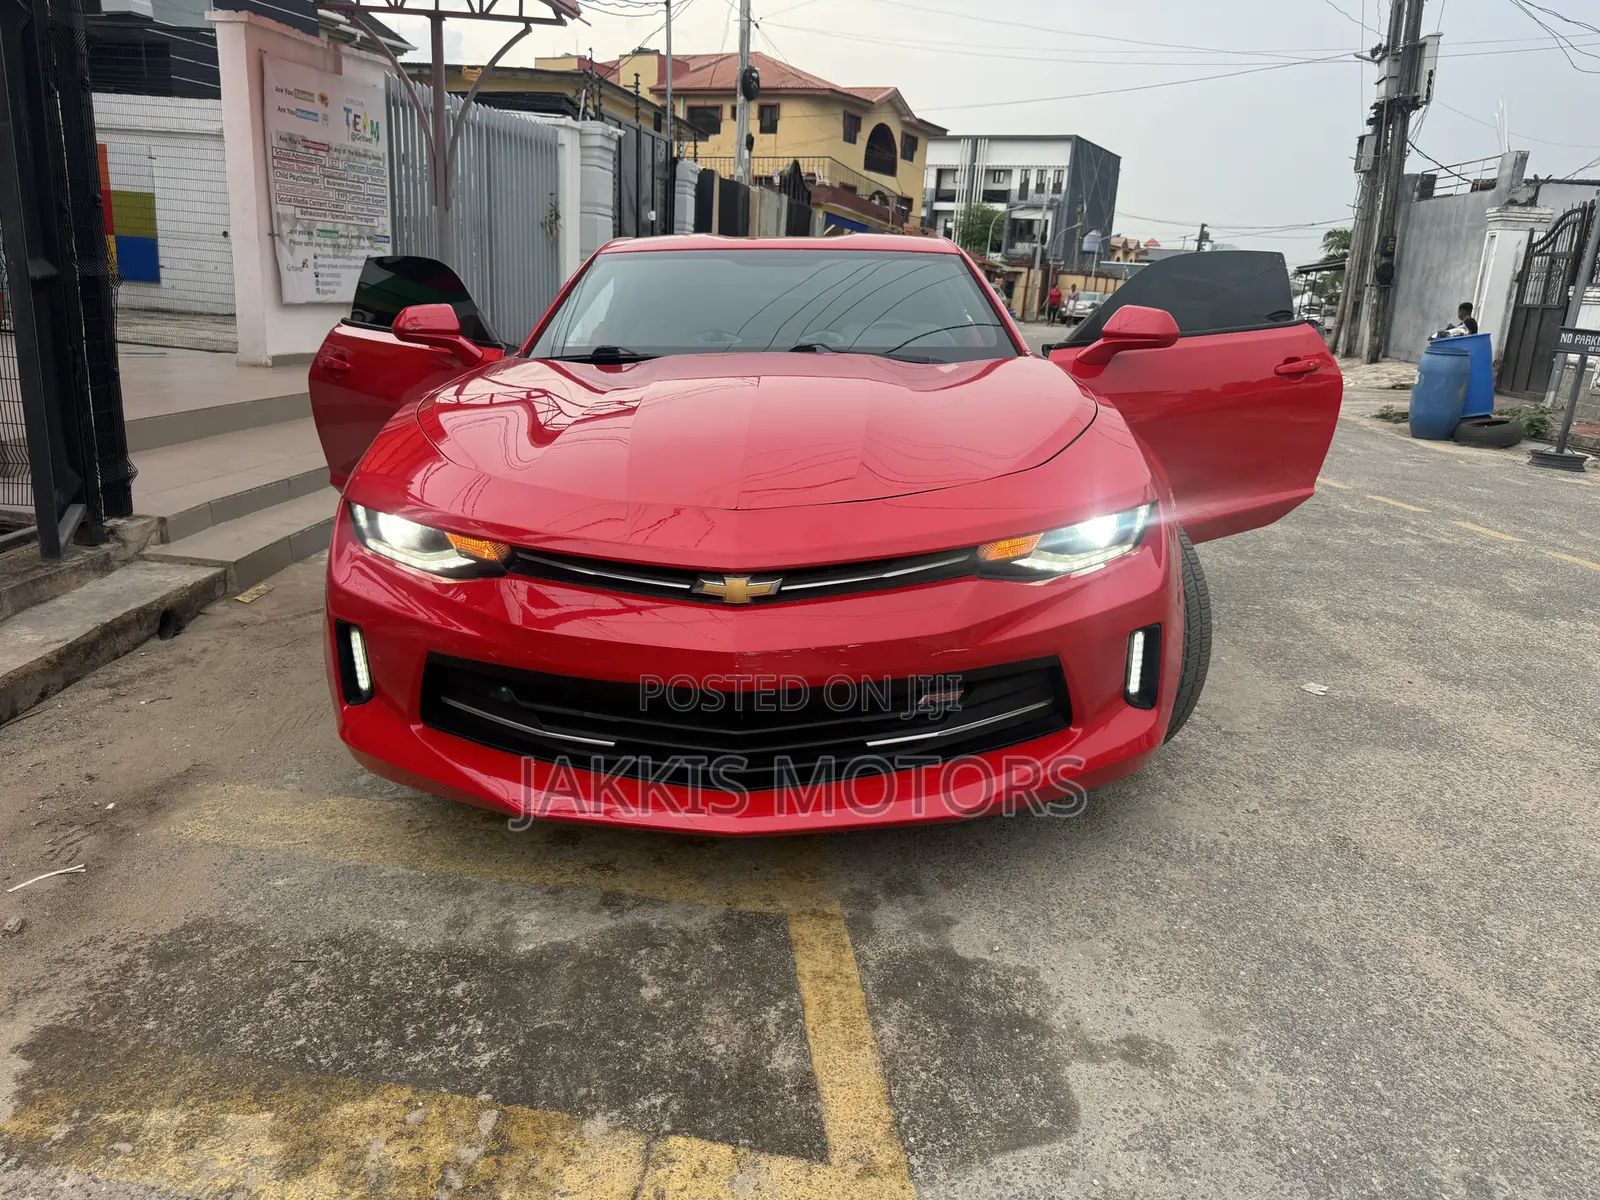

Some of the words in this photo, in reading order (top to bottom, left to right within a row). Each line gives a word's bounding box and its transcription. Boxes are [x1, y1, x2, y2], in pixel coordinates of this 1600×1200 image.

[275, 86, 284, 94] Are
[284, 88, 294, 96] You
[286, 108, 296, 116] You
[343, 106, 380, 141] TEAM
[280, 134, 288, 142] Are
[274, 149, 290, 158] School
[291, 152, 324, 163] Administrator
[276, 170, 288, 180] Child
[290, 172, 320, 184] Psychologist
[326, 180, 344, 188] Business
[278, 195, 292, 203] Social
[293, 197, 308, 206] Media
[328, 202, 344, 210] Creator
[348, 194, 370, 203] Curriculum
[372, 196, 386, 205] Expert
[1560, 333, 1573, 344] NO
